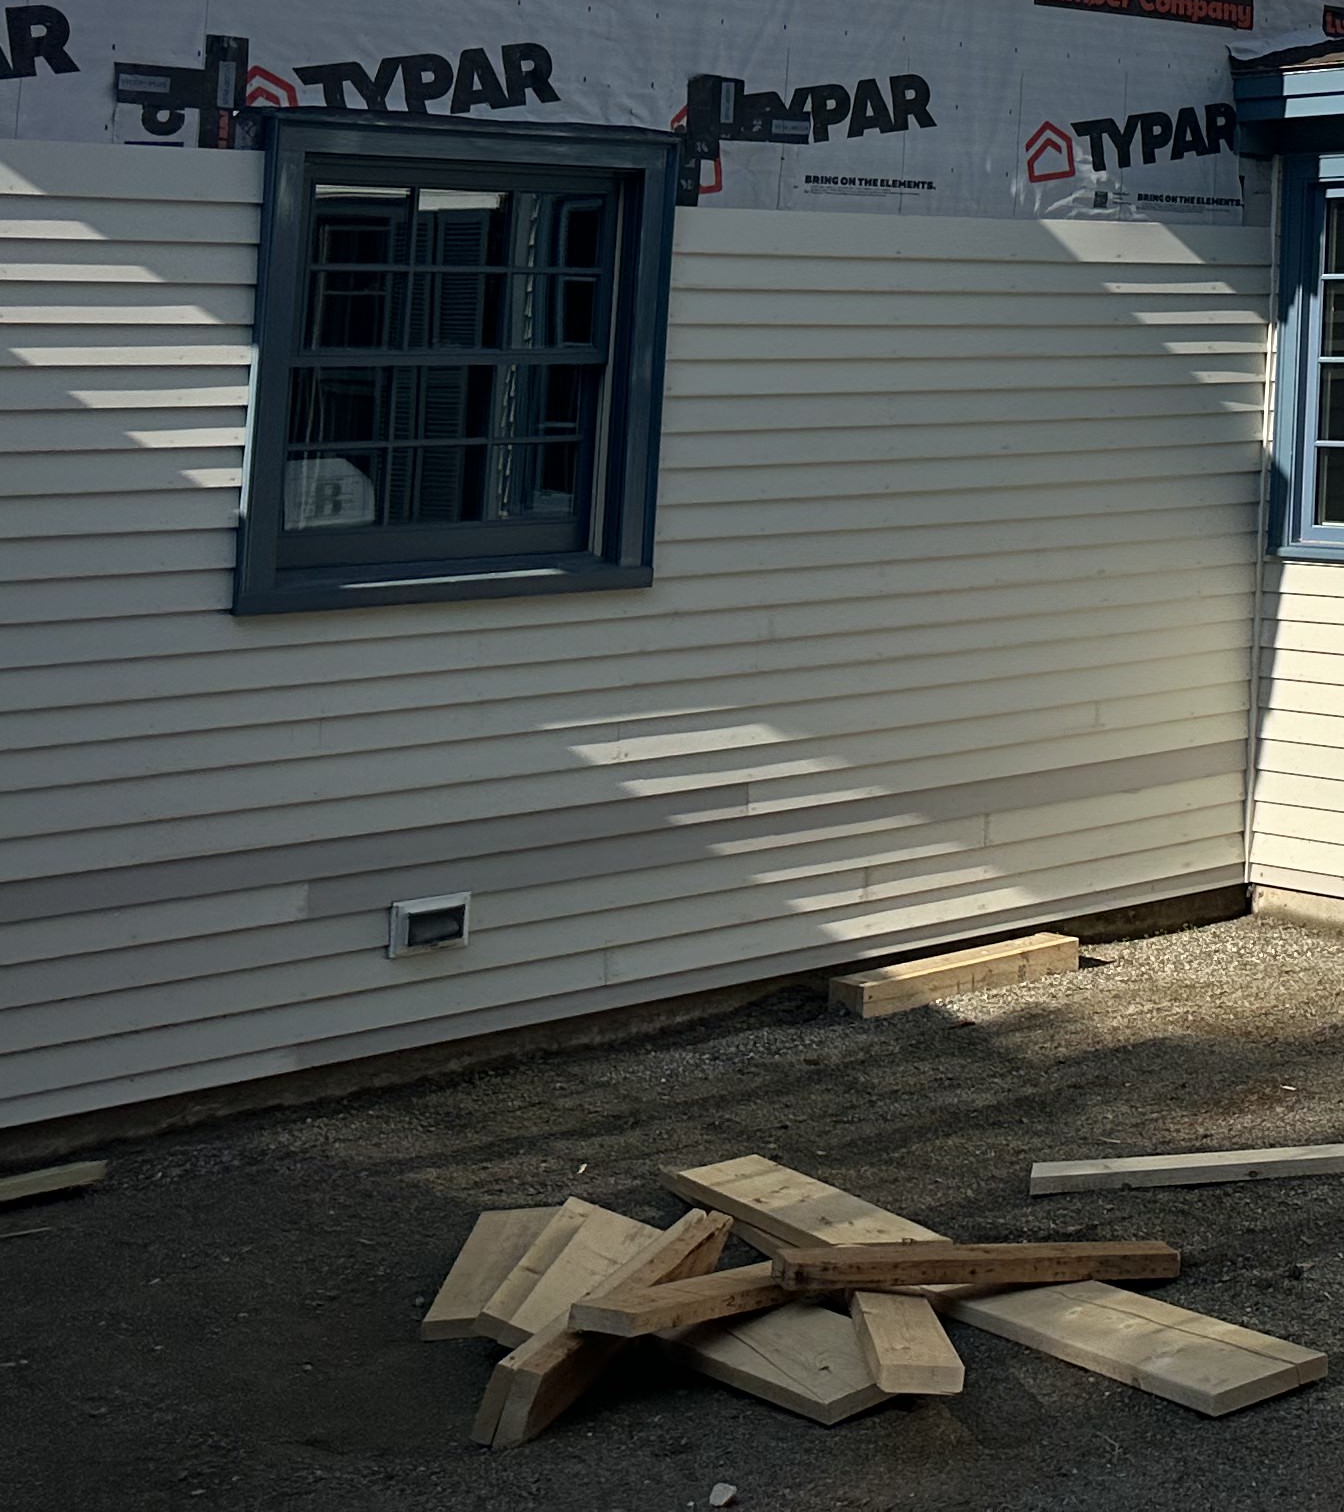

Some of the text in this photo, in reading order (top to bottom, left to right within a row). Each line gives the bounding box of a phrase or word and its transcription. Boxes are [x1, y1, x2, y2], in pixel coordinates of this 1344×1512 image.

[292, 42, 561, 115] TYPAR
[1070, 102, 1237, 172] TYPAR
[804, 174, 937, 191] BRING ON THE ELEMENTS.
